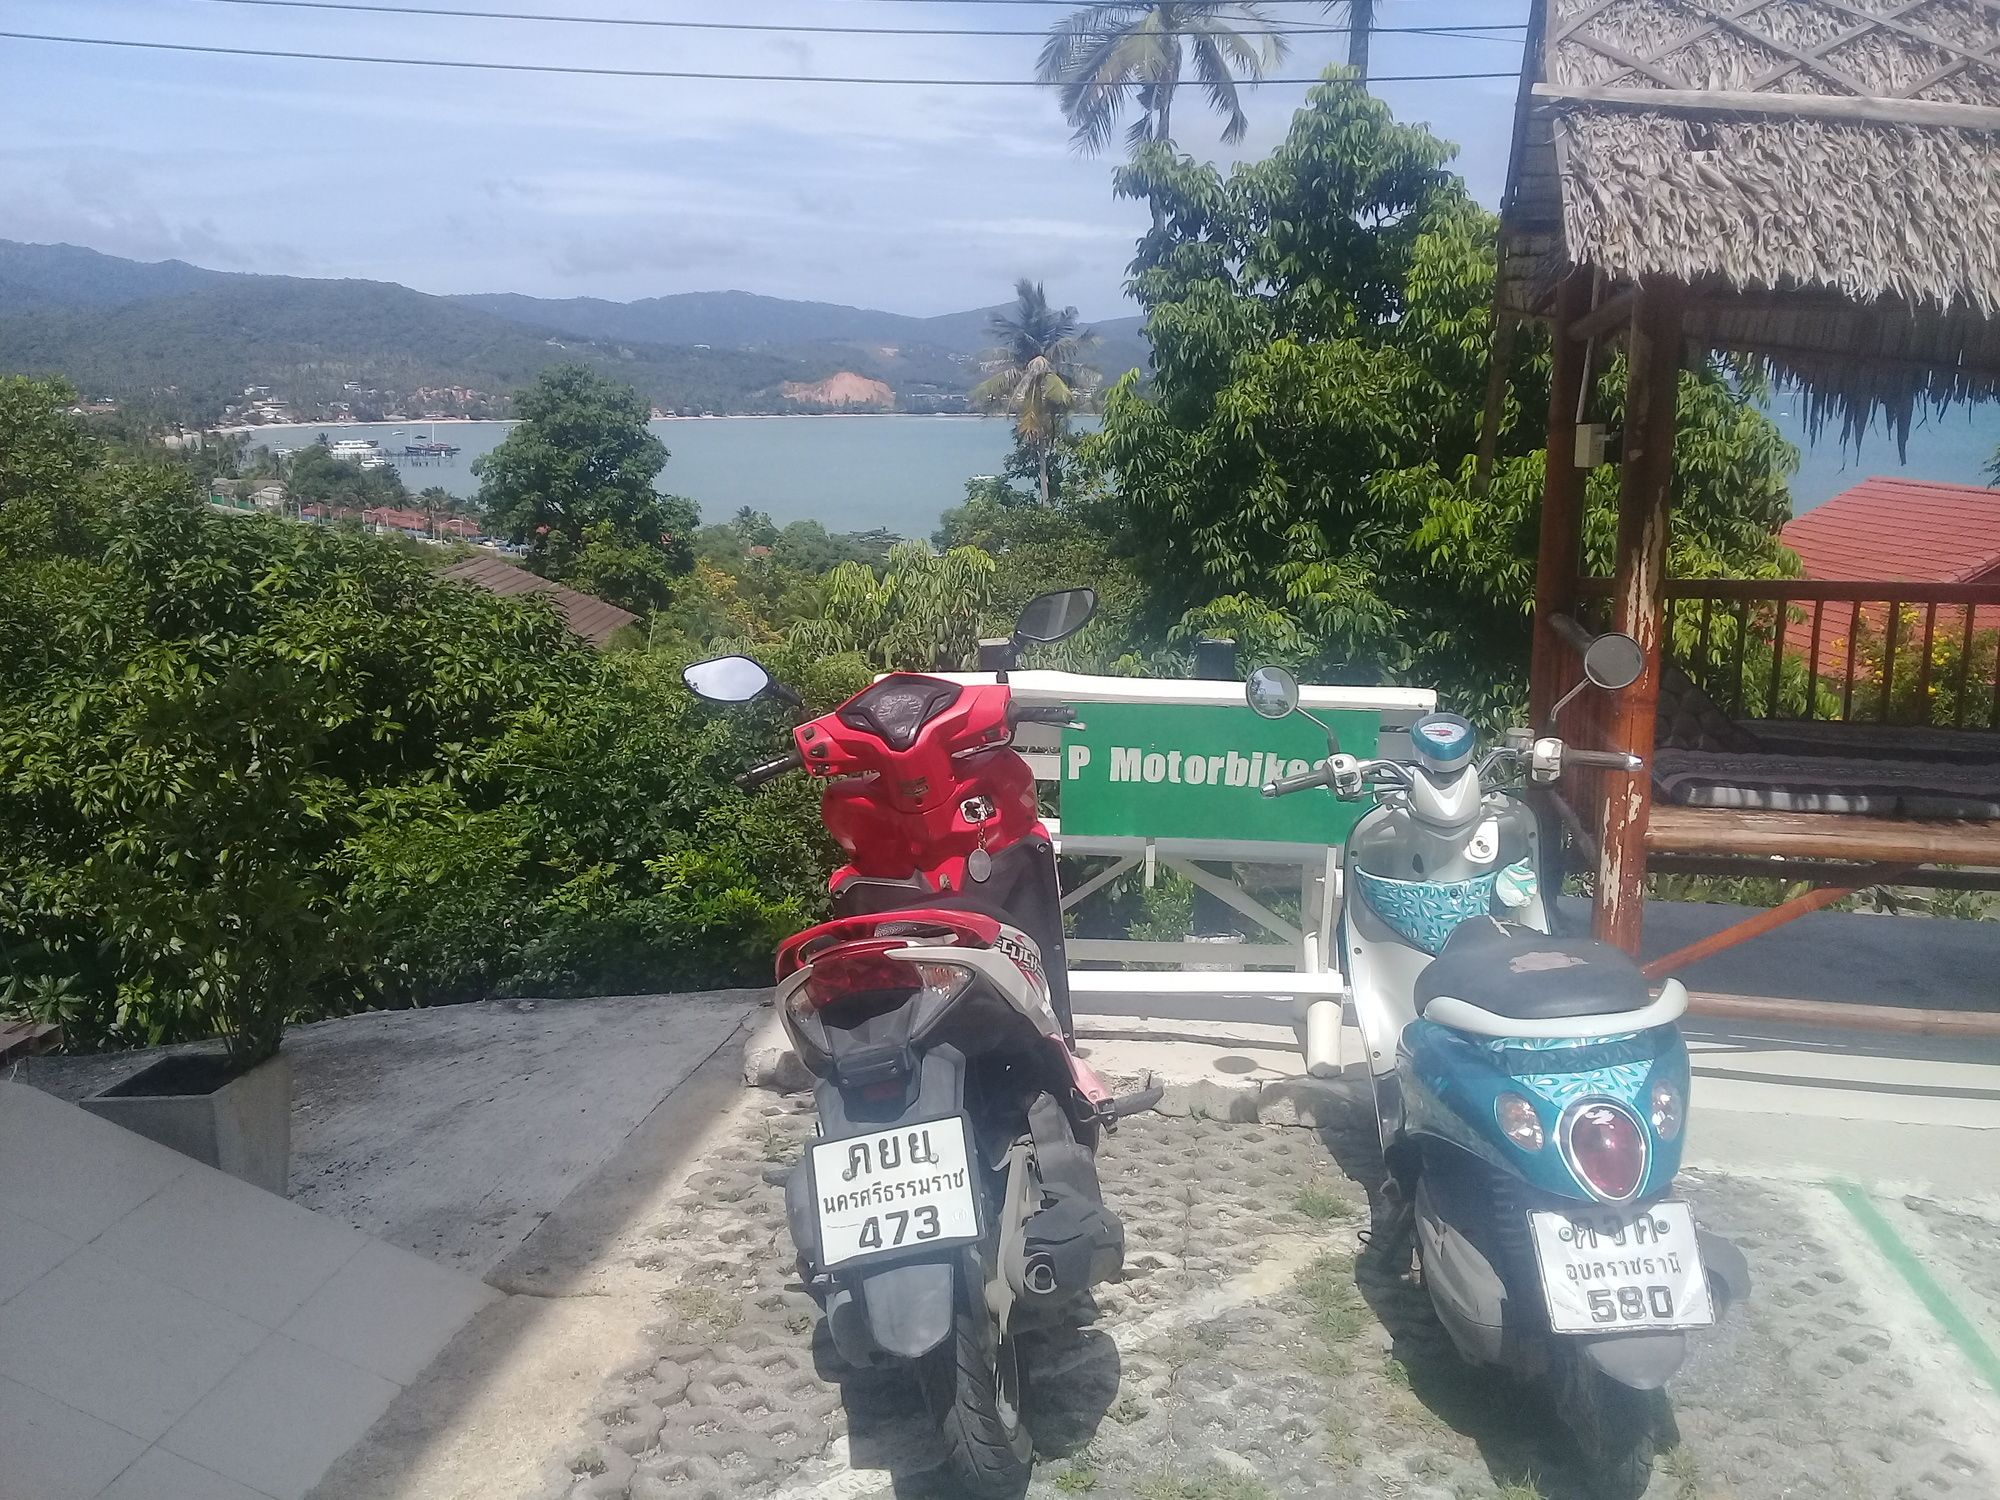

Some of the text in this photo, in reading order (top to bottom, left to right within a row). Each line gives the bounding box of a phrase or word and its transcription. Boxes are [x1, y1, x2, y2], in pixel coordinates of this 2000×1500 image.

[1068, 745, 1091, 780] P
[823, 1168, 965, 1214] นครศรีธรรมราช
[859, 1205, 941, 1249] 473
[1586, 1286, 1674, 1323] 580
